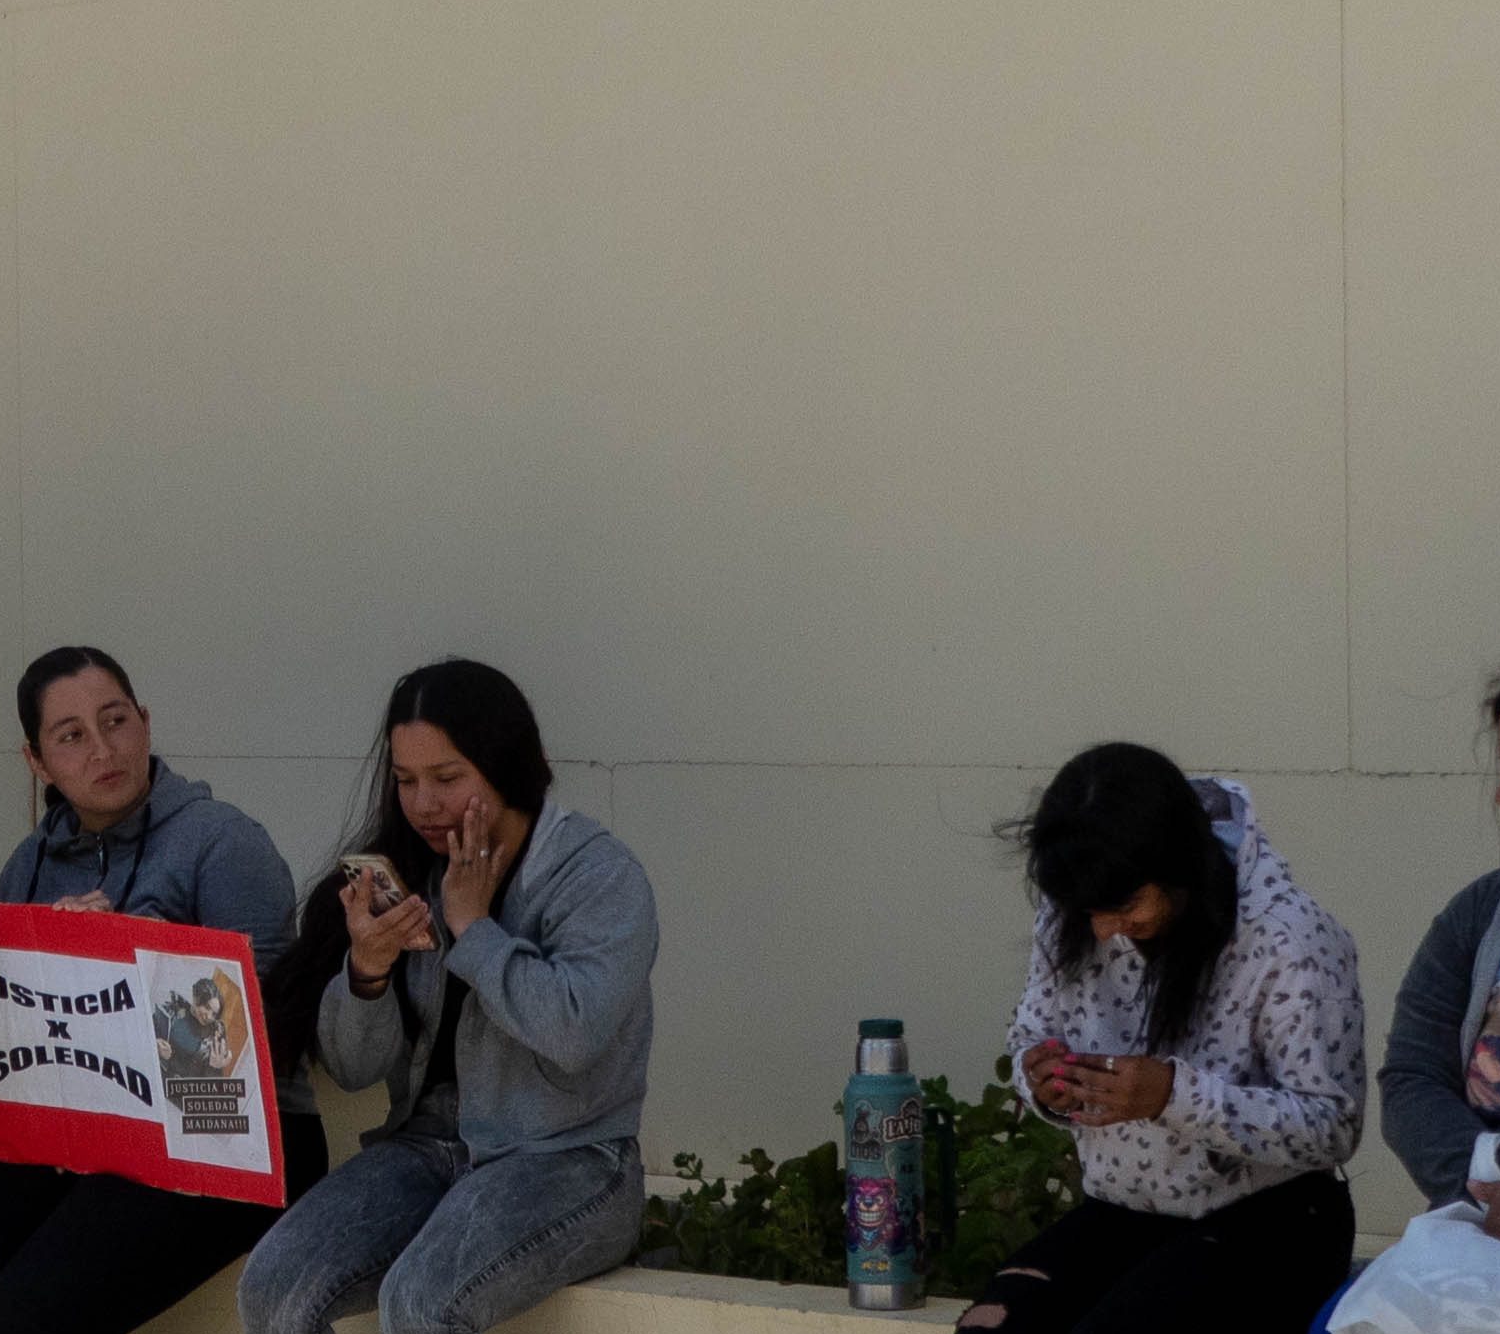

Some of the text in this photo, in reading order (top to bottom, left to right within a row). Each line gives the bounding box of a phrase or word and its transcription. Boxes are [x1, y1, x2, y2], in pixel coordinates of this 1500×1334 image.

[169, 1081, 243, 1094] JUSTICIA POR
[187, 1100, 236, 1112] SOLEDAD
[185, 1118, 247, 1131] MAIDANA!!!
